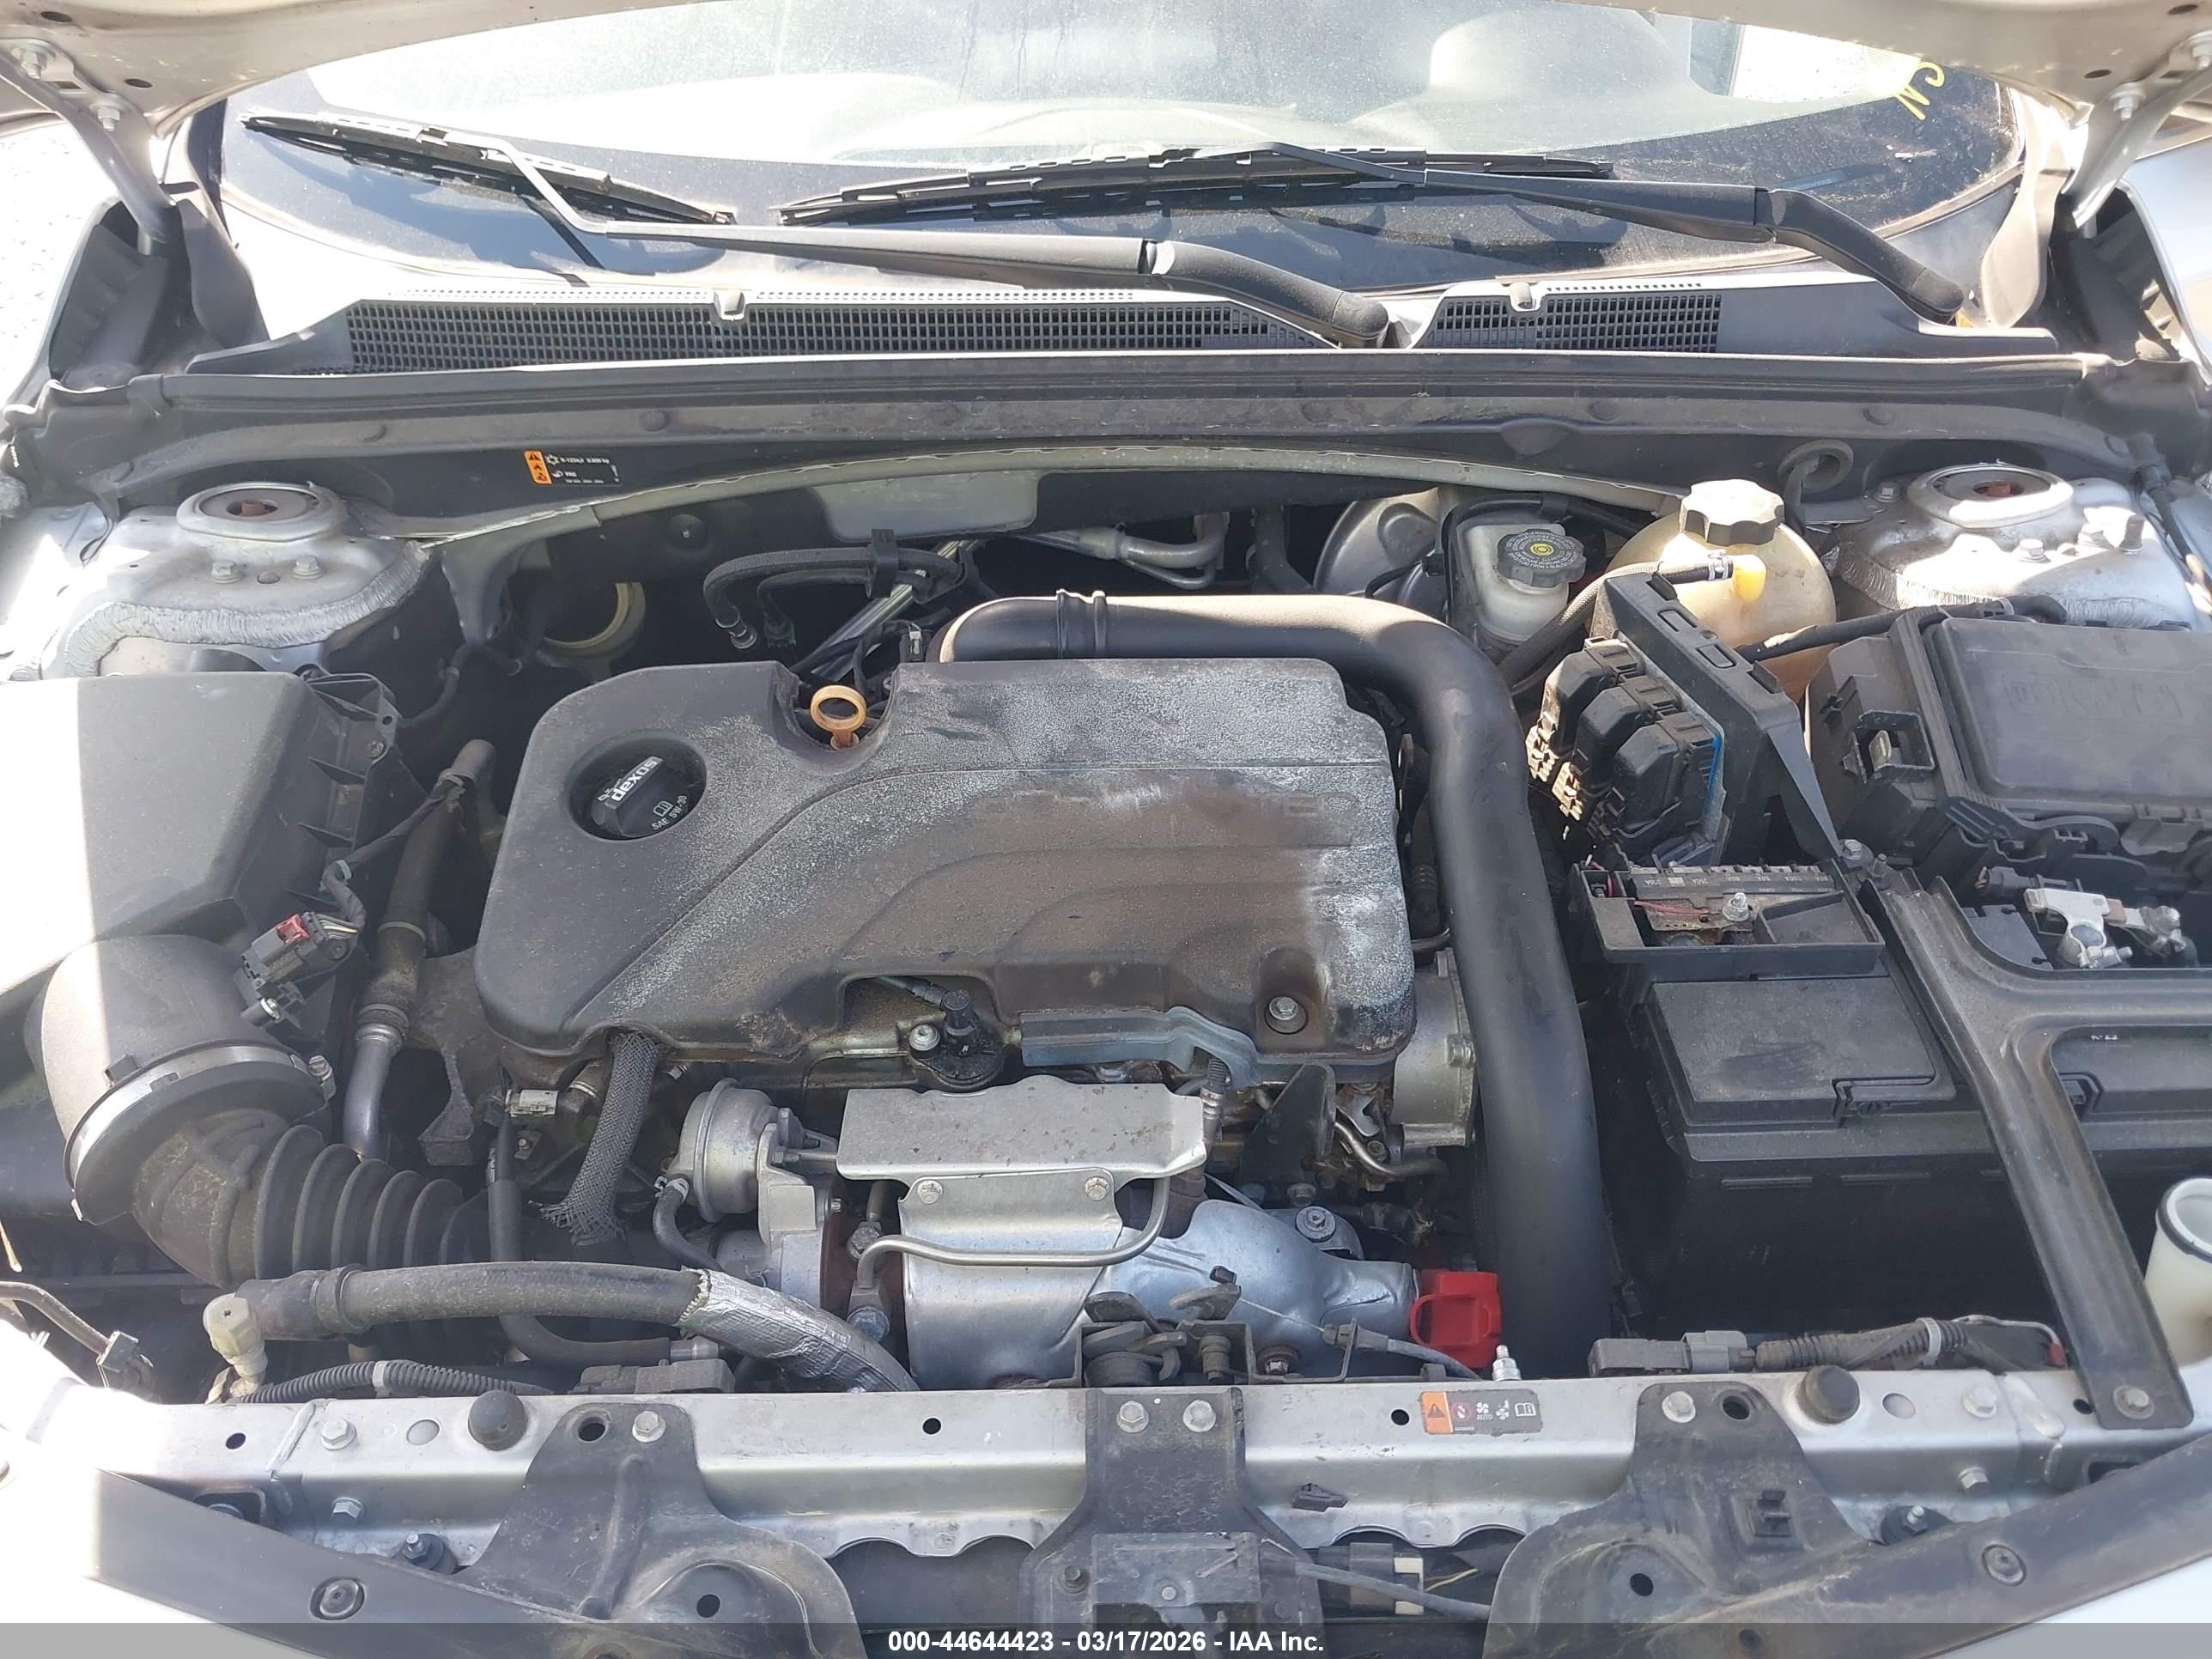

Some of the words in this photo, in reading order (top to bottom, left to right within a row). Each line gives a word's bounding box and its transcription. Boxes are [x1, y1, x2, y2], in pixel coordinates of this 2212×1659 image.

[611, 759, 658, 801] dexos
[652, 818, 670, 830] SAE
[669, 795, 688, 819] 5W-30
